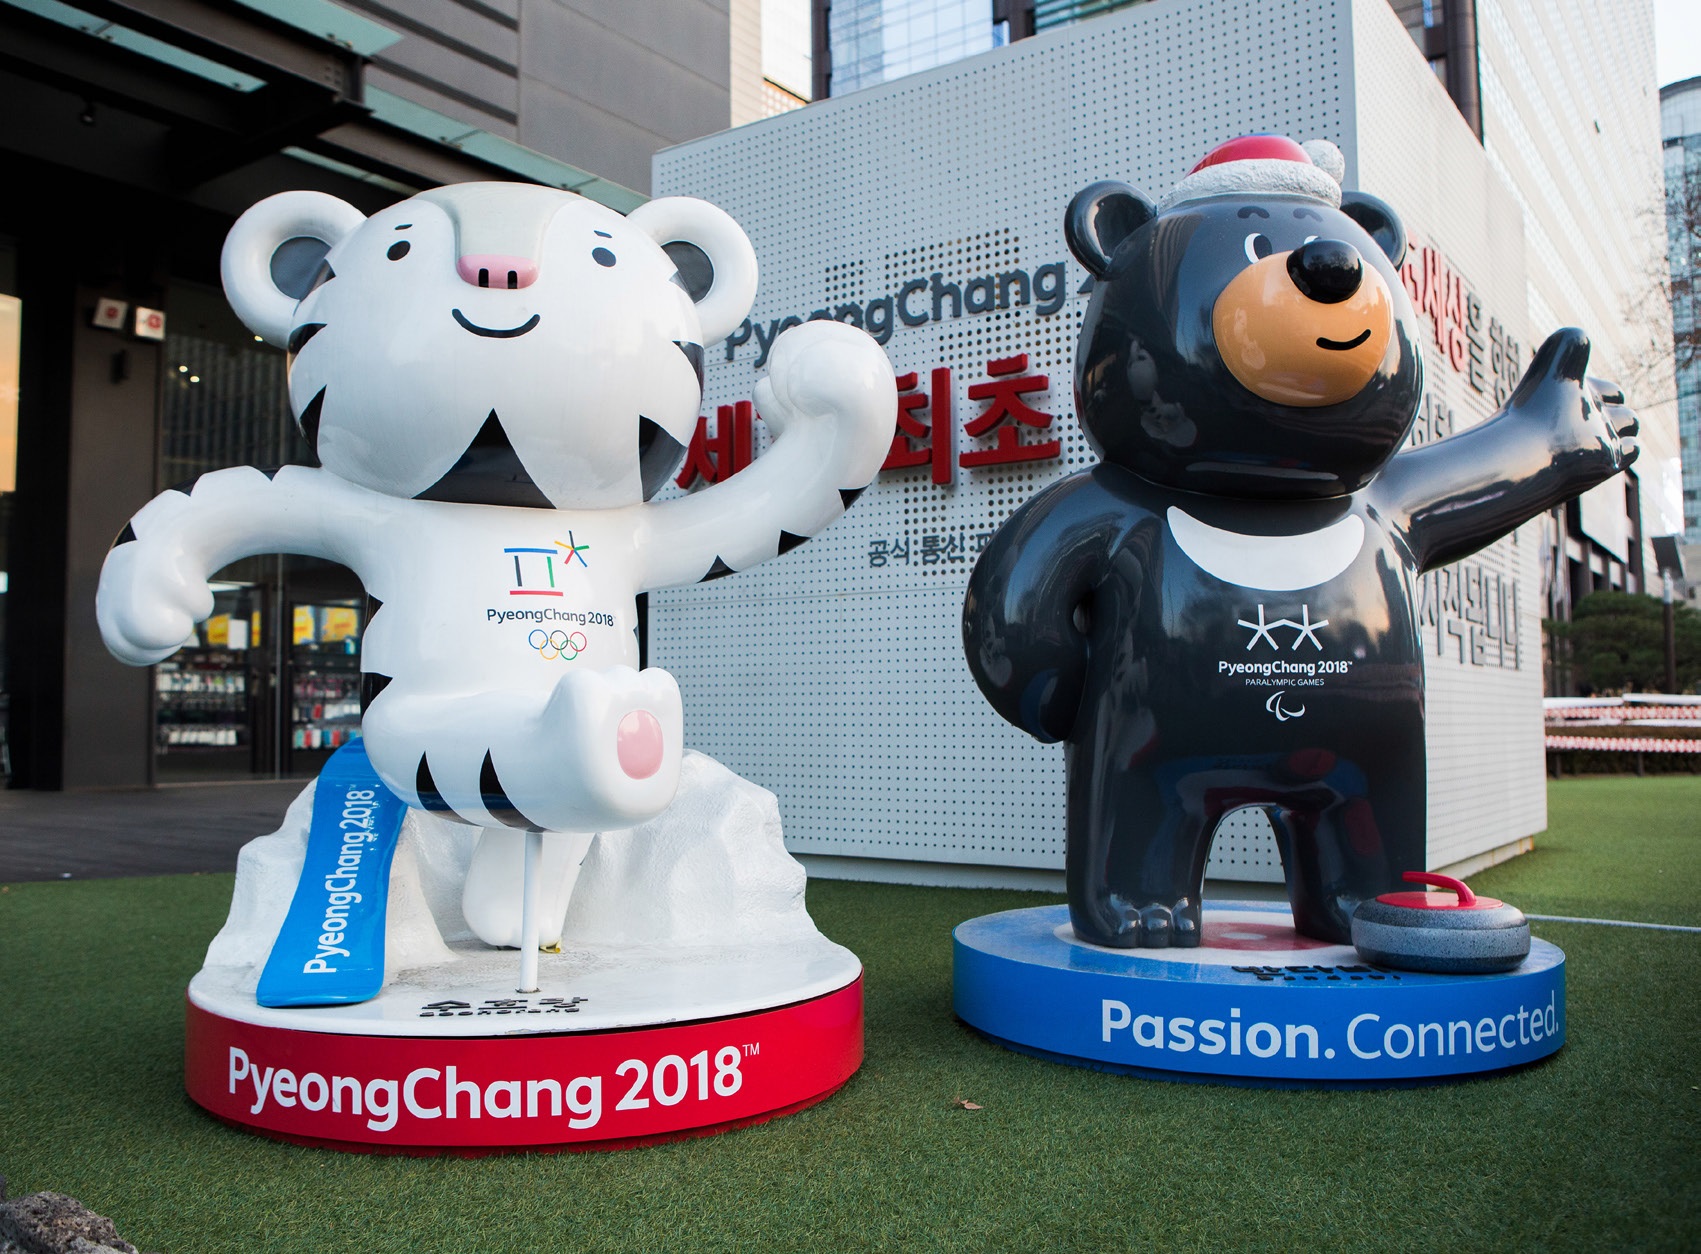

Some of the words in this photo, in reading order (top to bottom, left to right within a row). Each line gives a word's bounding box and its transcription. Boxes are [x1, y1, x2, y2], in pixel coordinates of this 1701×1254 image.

[868, 536, 910, 567] 공식
[920, 532, 966, 563] 통신
[487, 608, 586, 626] PyeongChang
[588, 611, 614, 627] 2018
[1218, 660, 1315, 676] PyeongChang
[1245, 678, 1296, 686] PARALYMPIC
[1297, 678, 1325, 686] GAMES
[303, 832, 372, 974] PyeongChang
[421, 996, 588, 1012] 수호랑
[1102, 999, 1337, 1060] Passion.
[1347, 989, 1559, 1061] Connected.
[228, 1046, 602, 1132] PyeongChang
